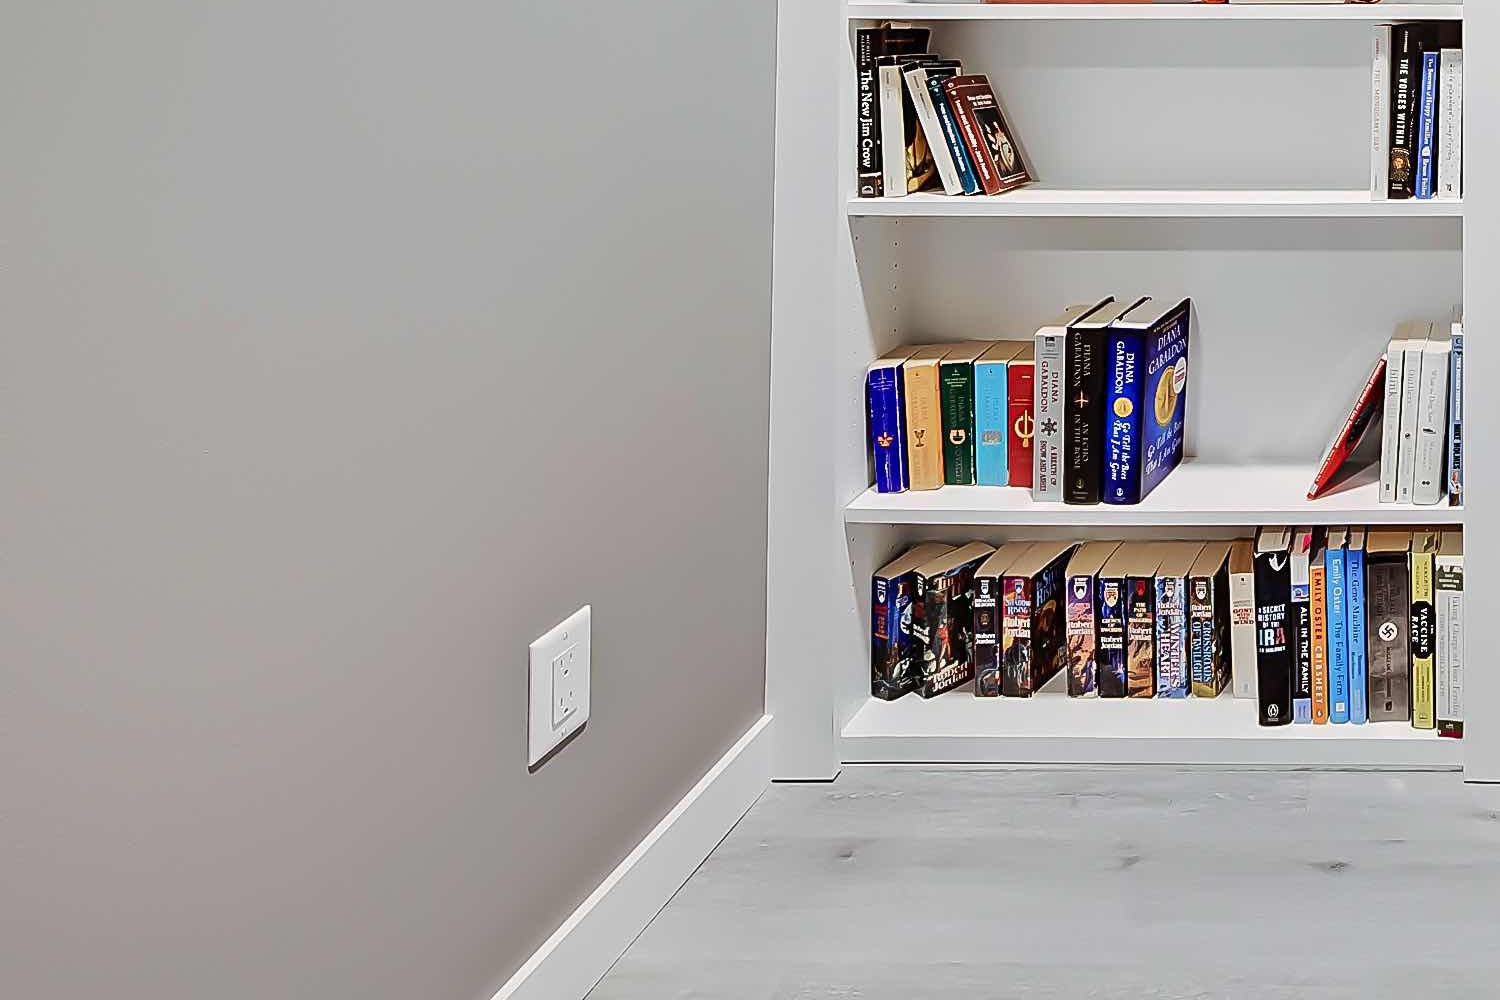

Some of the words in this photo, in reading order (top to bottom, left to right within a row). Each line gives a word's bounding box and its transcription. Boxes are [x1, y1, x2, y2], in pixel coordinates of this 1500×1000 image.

[861, 70, 873, 91] The
[1400, 59, 1409, 74] THE
[861, 93, 873, 115] New
[1397, 78, 1407, 110] VOICES
[859, 116, 873, 137] Jim
[1396, 114, 1406, 144] WITHIN
[861, 139, 873, 168] Crow
[1158, 325, 1180, 350] DIANA
[1074, 333, 1082, 387] GABALDON
[1083, 344, 1091, 376] DIANA
[1115, 341, 1125, 393] GABALDON
[1126, 353, 1134, 383] DIANA
[1148, 336, 1186, 375] GABALDON
[1121, 423, 1130, 433] Go
[1110, 462, 1120, 480] Gone
[1121, 462, 1129, 480] Bees
[1331, 559, 1341, 586] Emily
[1314, 572, 1322, 603] EMILY
[1332, 587, 1342, 616] Oster
[1258, 612, 1285, 620] HISTORY
[1262, 604, 1285, 612] SECRET
[1300, 607, 1308, 625] ALL
[1193, 622, 1202, 634] OF
[1259, 628, 1285, 646] IRA
[1301, 628, 1308, 638] IN
[1314, 609, 1322, 640] OSTER
[1334, 621, 1343, 638] The
[1420, 608, 1428, 652] VACCINE
[1160, 632, 1170, 678] HEART
[1170, 623, 1180, 688] WINTER'S
[1192, 636, 1202, 682] TWILIGHT
[1203, 621, 1212, 682] CROSSROADS
[1333, 641, 1343, 676] Family
[1301, 659, 1309, 694] FAMILY
[1315, 645, 1323, 704] CRIBSHEET
